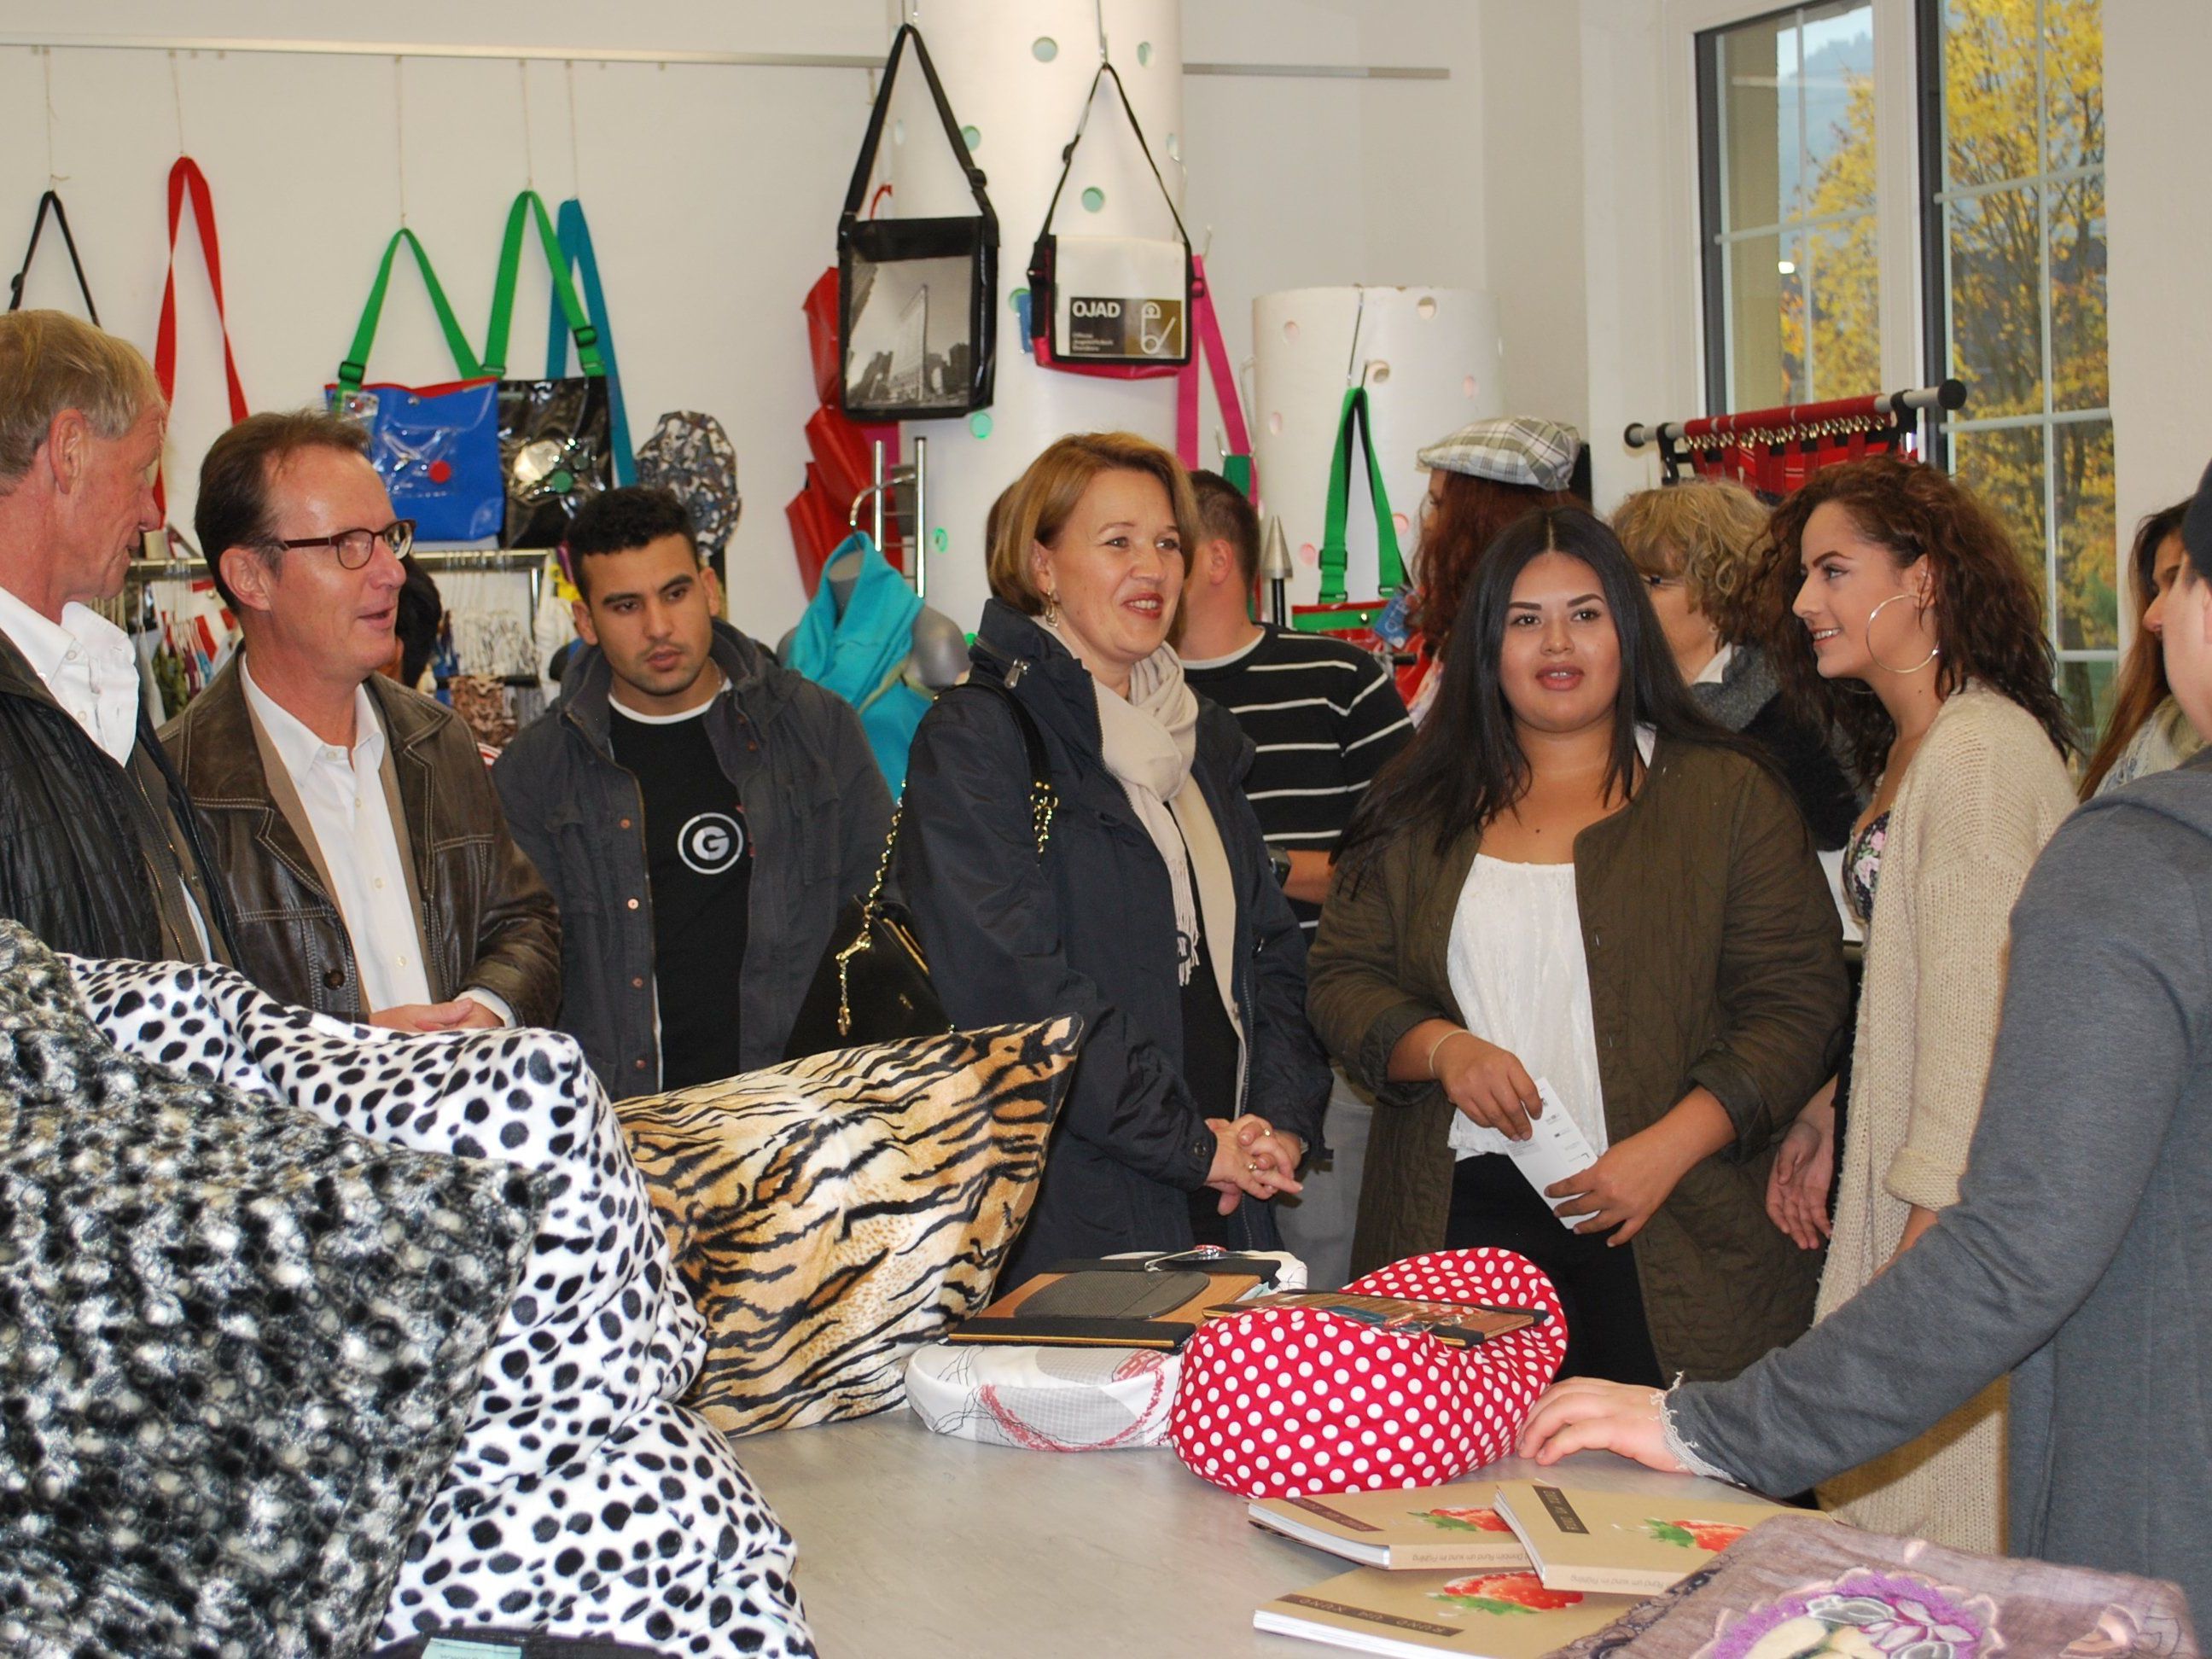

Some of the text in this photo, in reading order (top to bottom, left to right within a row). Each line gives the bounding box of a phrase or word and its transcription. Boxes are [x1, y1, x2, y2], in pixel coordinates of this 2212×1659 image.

[1072, 301, 1121, 318] OJAD
[692, 825, 730, 861] G
[1396, 1619, 1447, 1633] RUND
